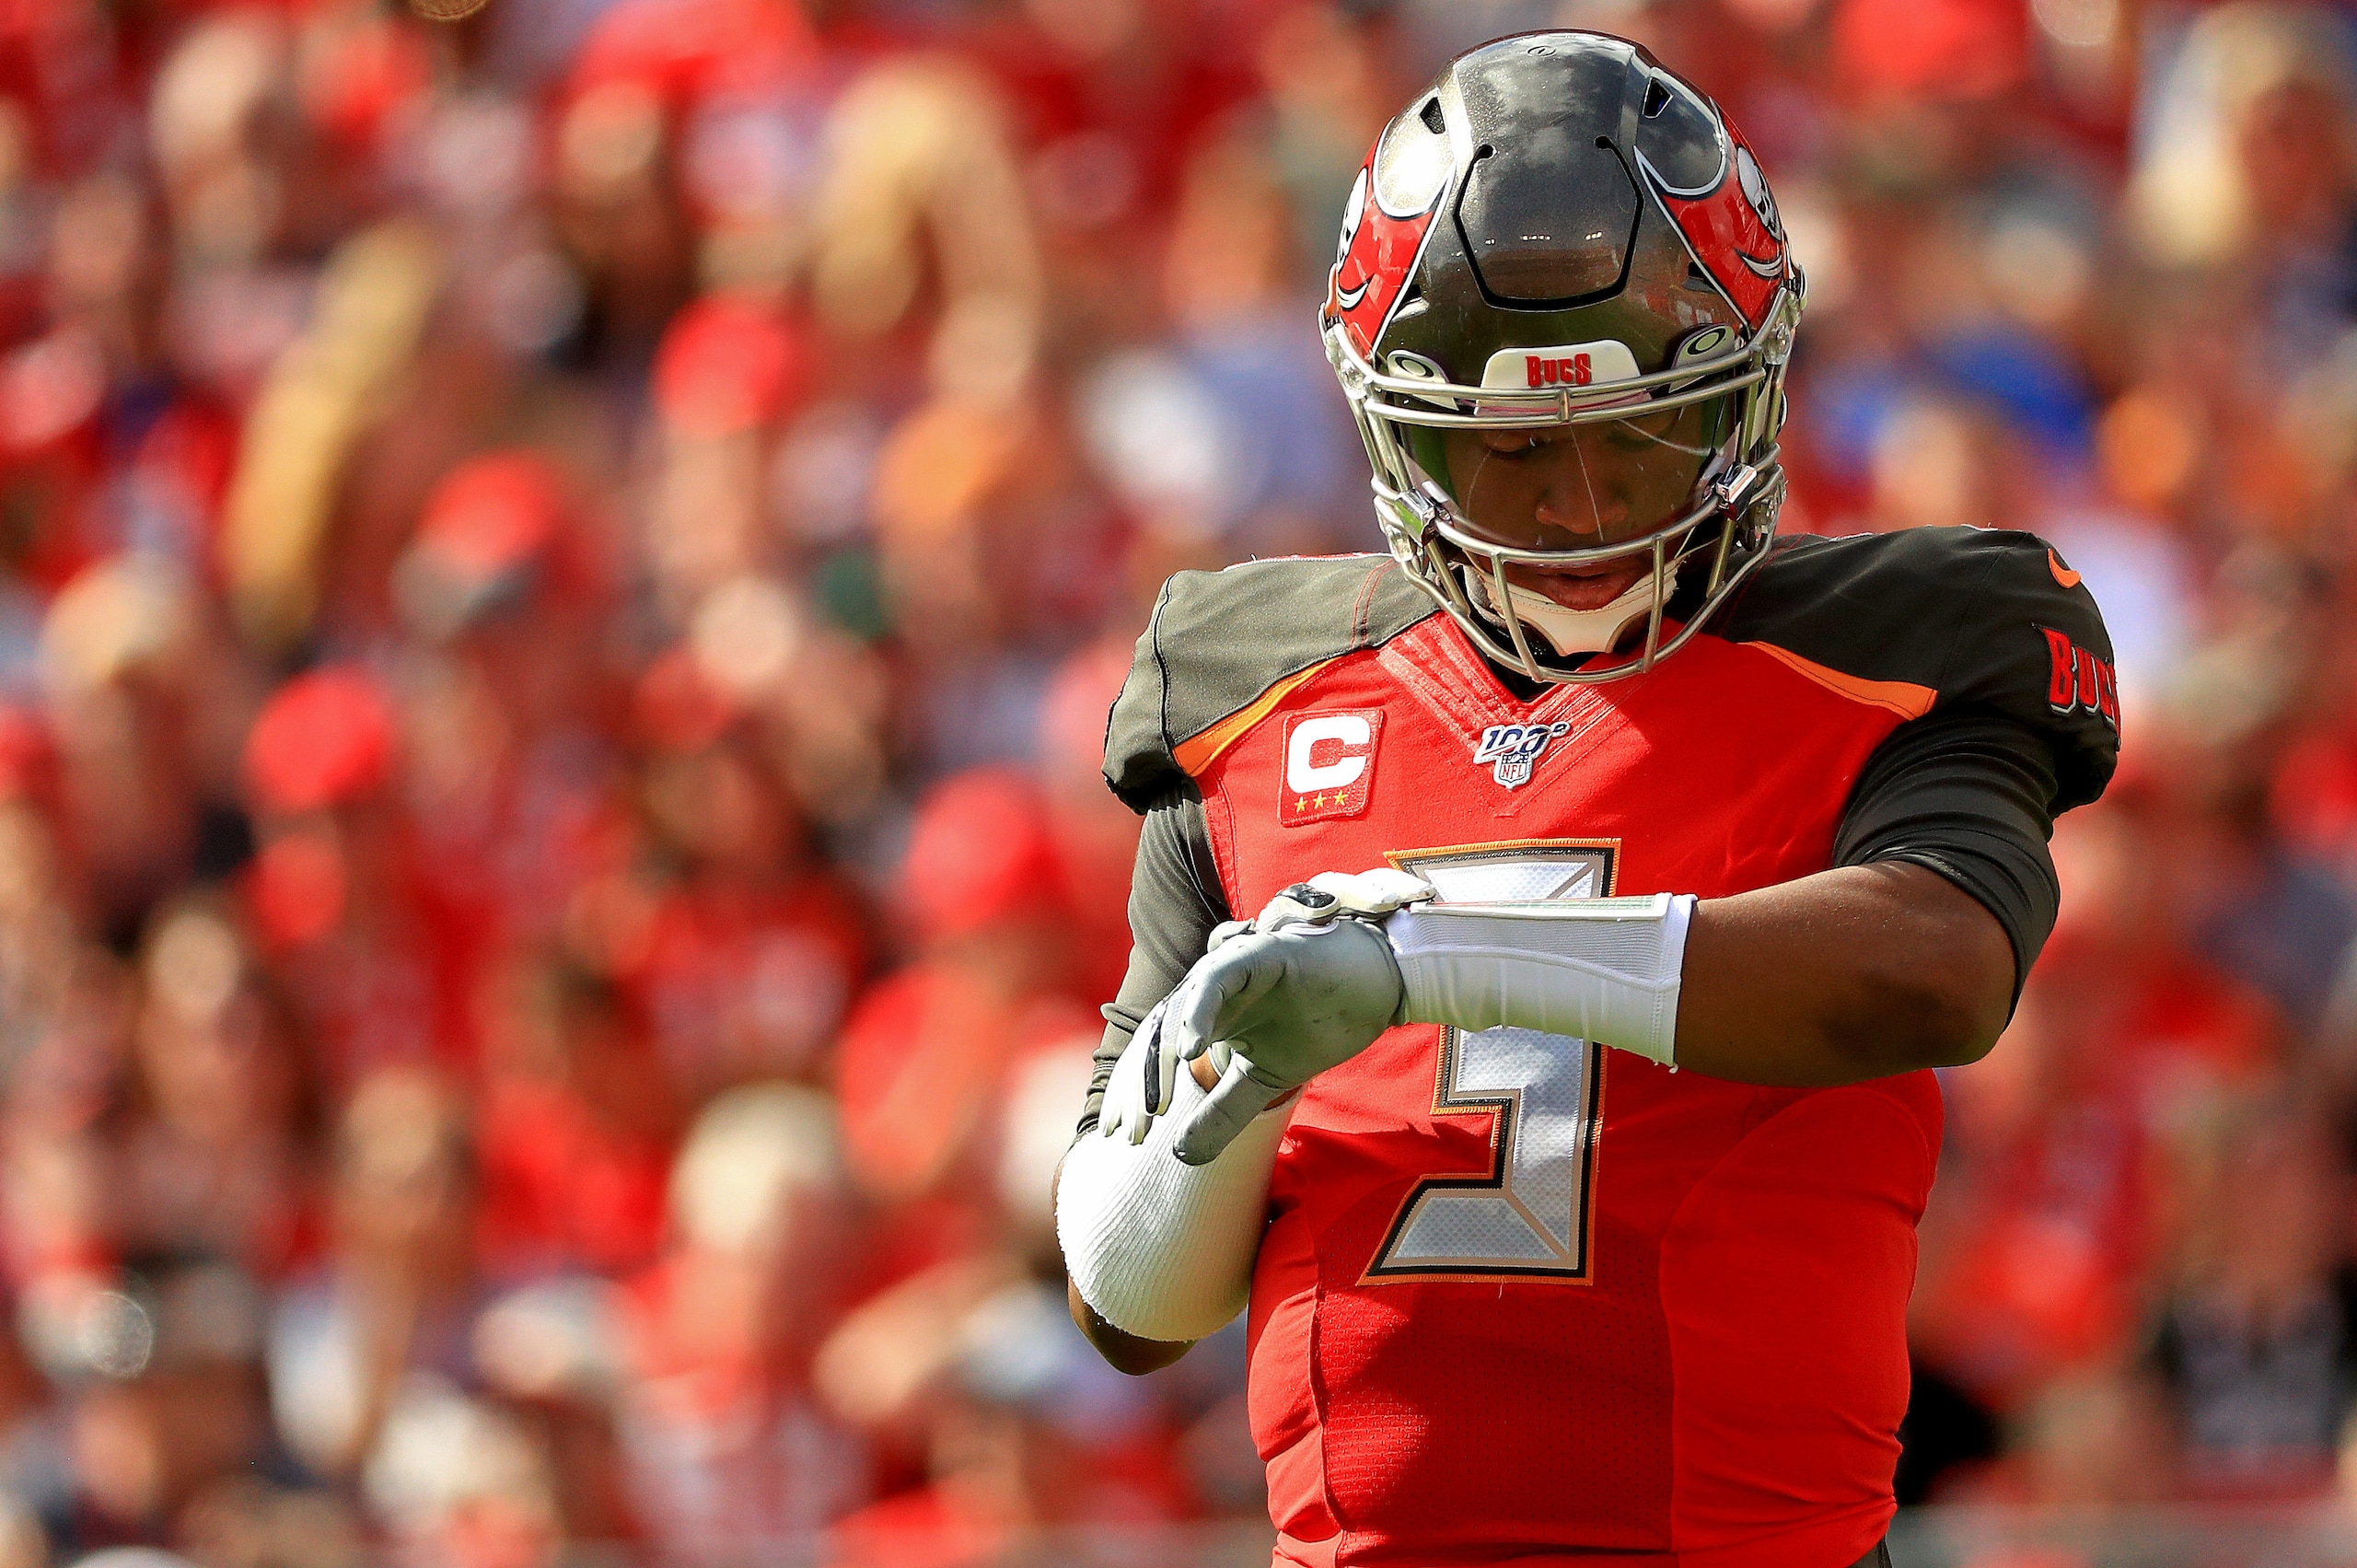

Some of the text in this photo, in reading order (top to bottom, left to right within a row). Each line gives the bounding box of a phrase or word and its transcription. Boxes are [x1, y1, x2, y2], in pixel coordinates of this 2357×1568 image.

[1525, 353, 1591, 388] BUCS
[1286, 715, 1371, 794] C
[1502, 763, 1526, 780] NFL
[1355, 837, 1621, 1285] 3
